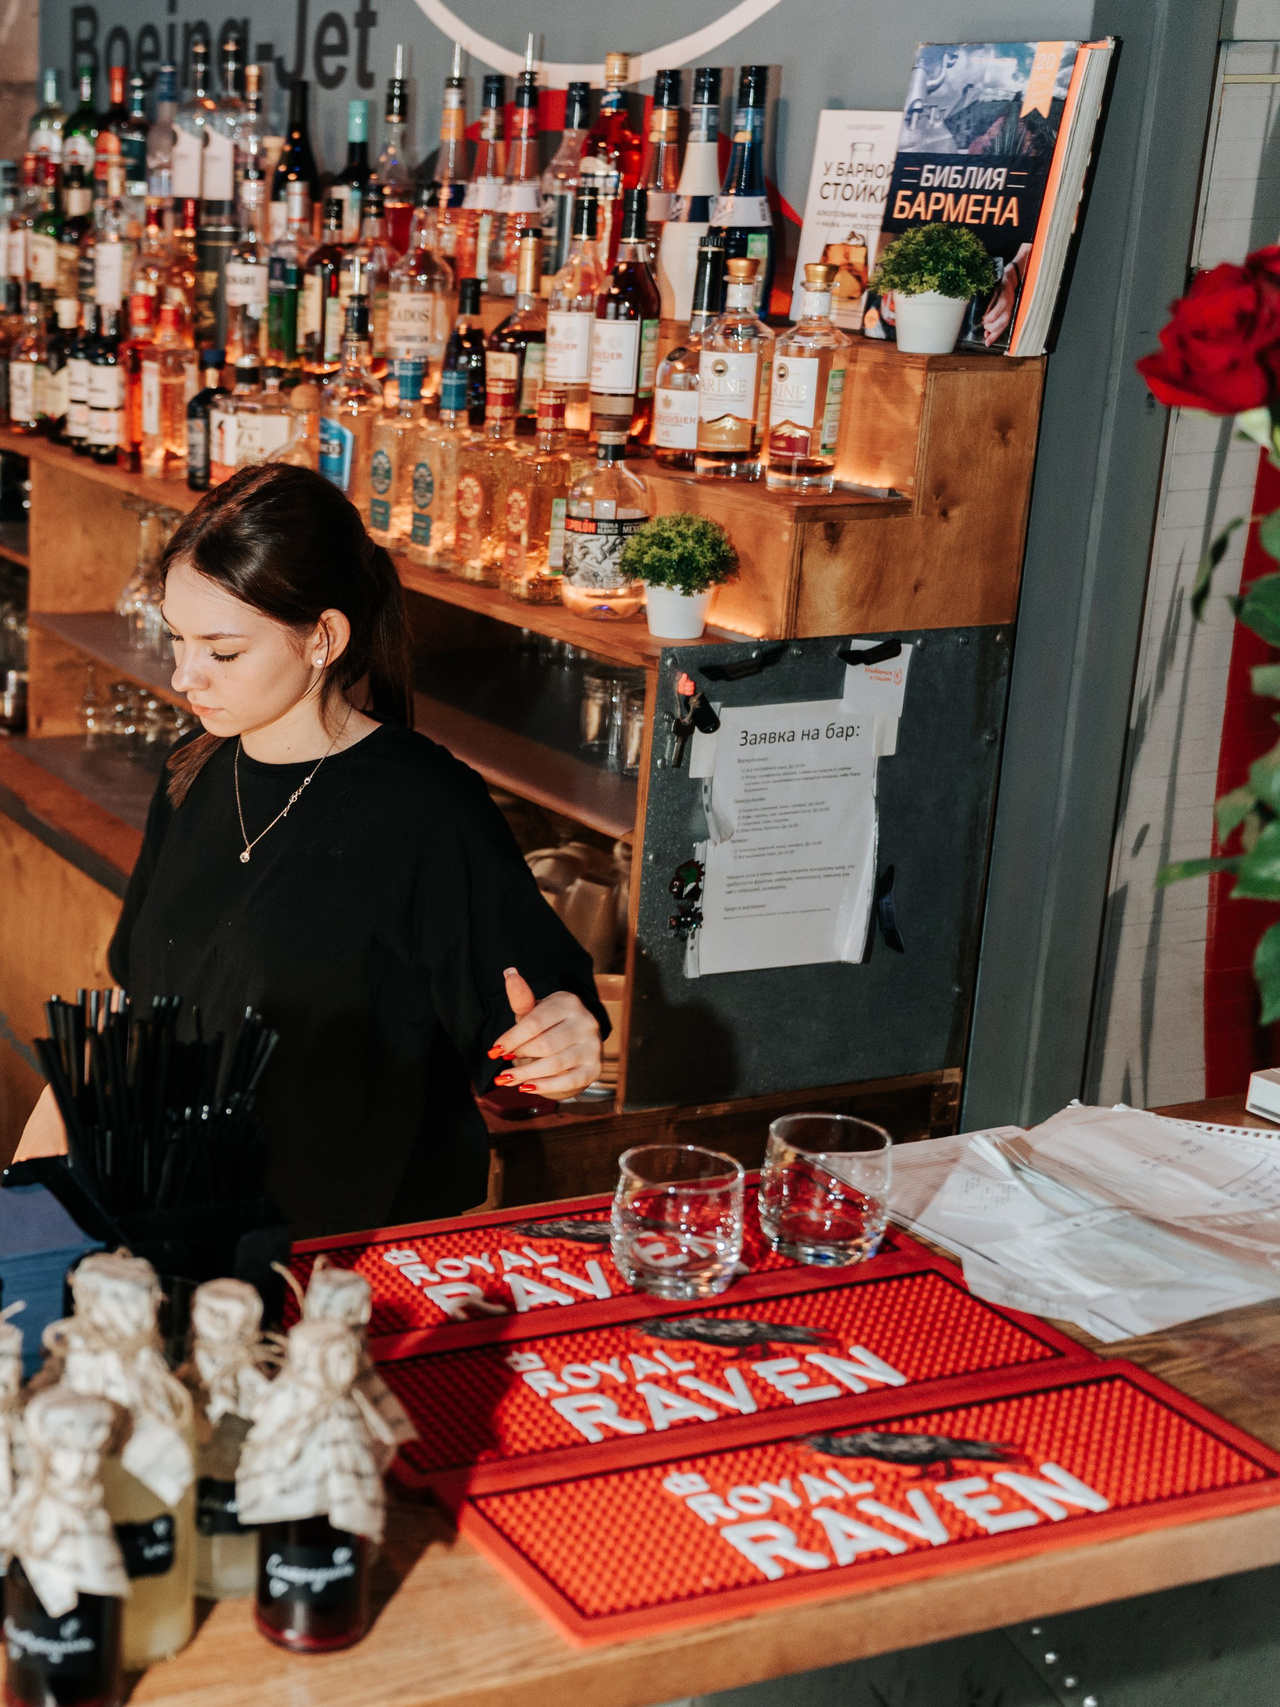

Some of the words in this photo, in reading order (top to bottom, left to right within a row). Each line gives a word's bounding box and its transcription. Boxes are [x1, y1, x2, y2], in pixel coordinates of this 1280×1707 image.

[1034, 53, 1056, 70] 20
[823, 161, 833, 177] У
[919, 164, 1009, 191] БИБЛИЯ
[892, 189, 1020, 228] БАРМЕНА
[739, 729, 796, 746] Заявка
[800, 727, 820, 741] на
[825, 722, 861, 742] бар:
[399, 1246, 559, 1286] ROYAL
[522, 1350, 695, 1397] ROYAL
[551, 1345, 907, 1443] RAVEN
[685, 1469, 875, 1525] ROYAL
[721, 1462, 1108, 1580] RAVEN
